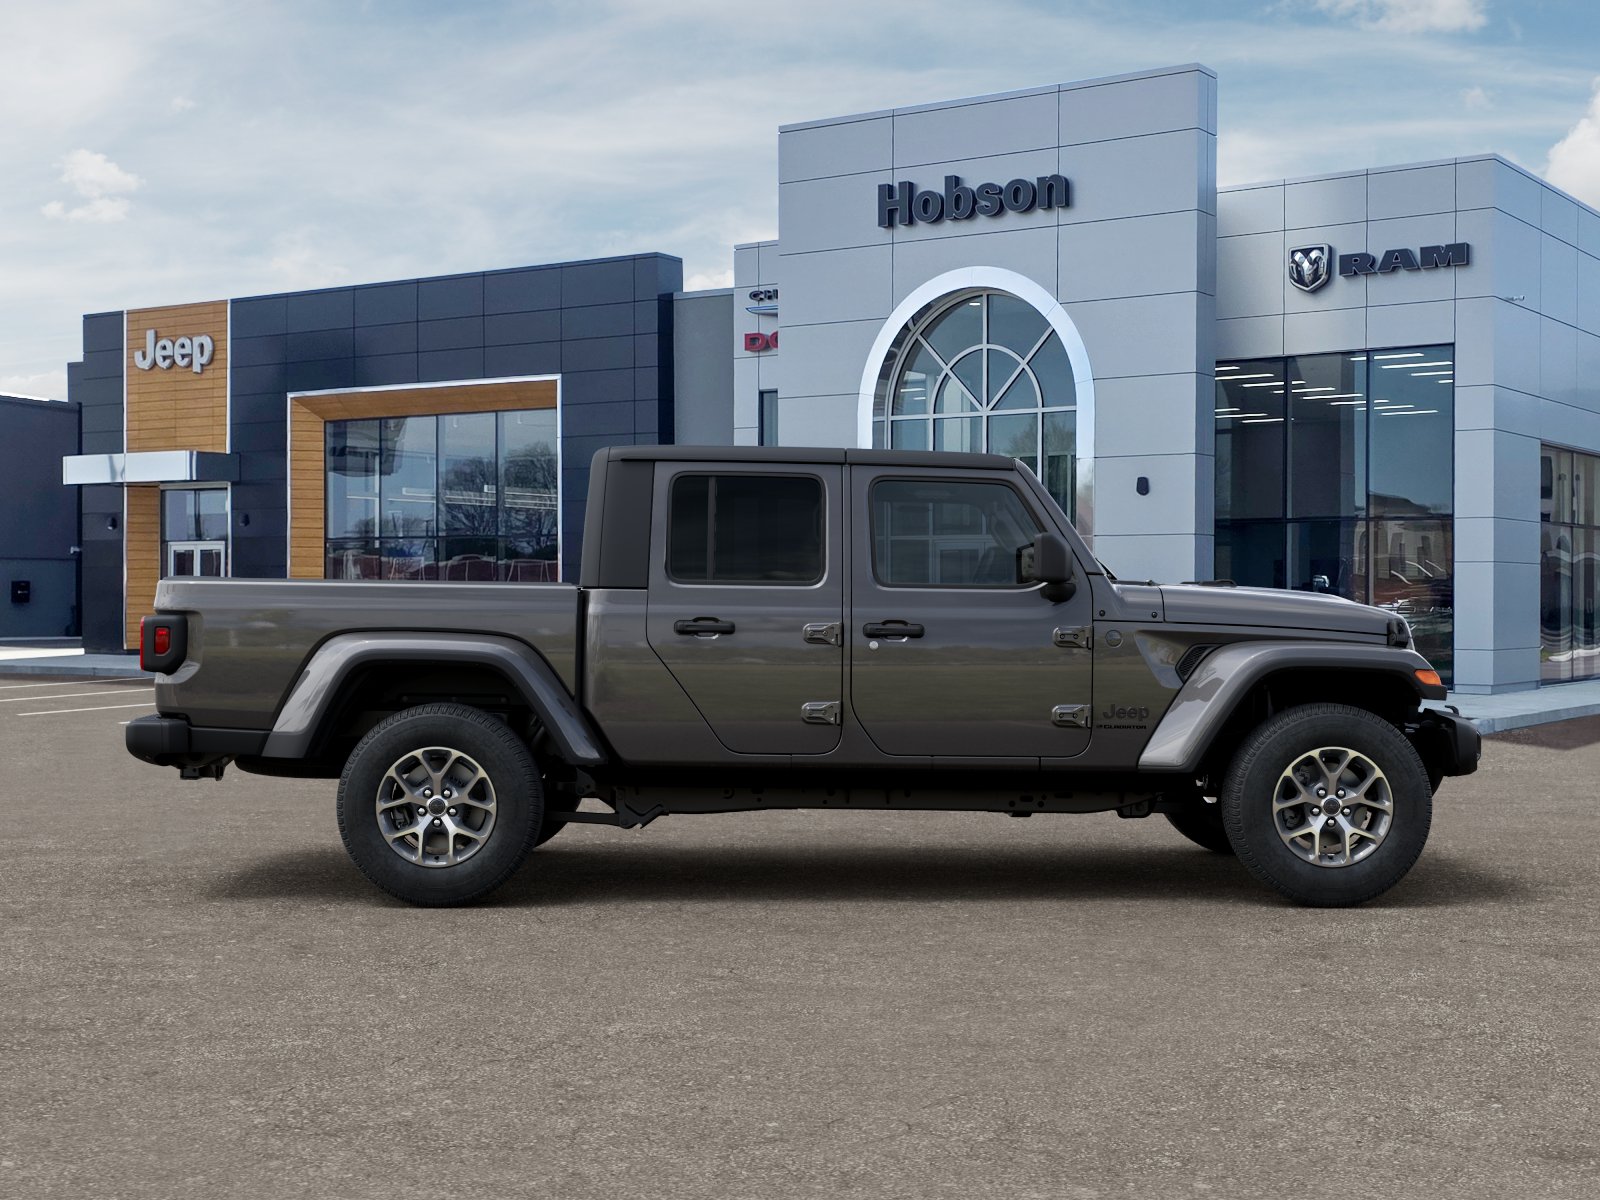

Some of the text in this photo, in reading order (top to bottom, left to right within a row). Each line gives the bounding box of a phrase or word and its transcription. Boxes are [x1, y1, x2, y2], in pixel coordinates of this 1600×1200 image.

[878, 174, 1070, 228] Hobson
[1339, 242, 1470, 277] RAM
[134, 328, 214, 374] Jeep
[1102, 703, 1150, 722] Jeep
